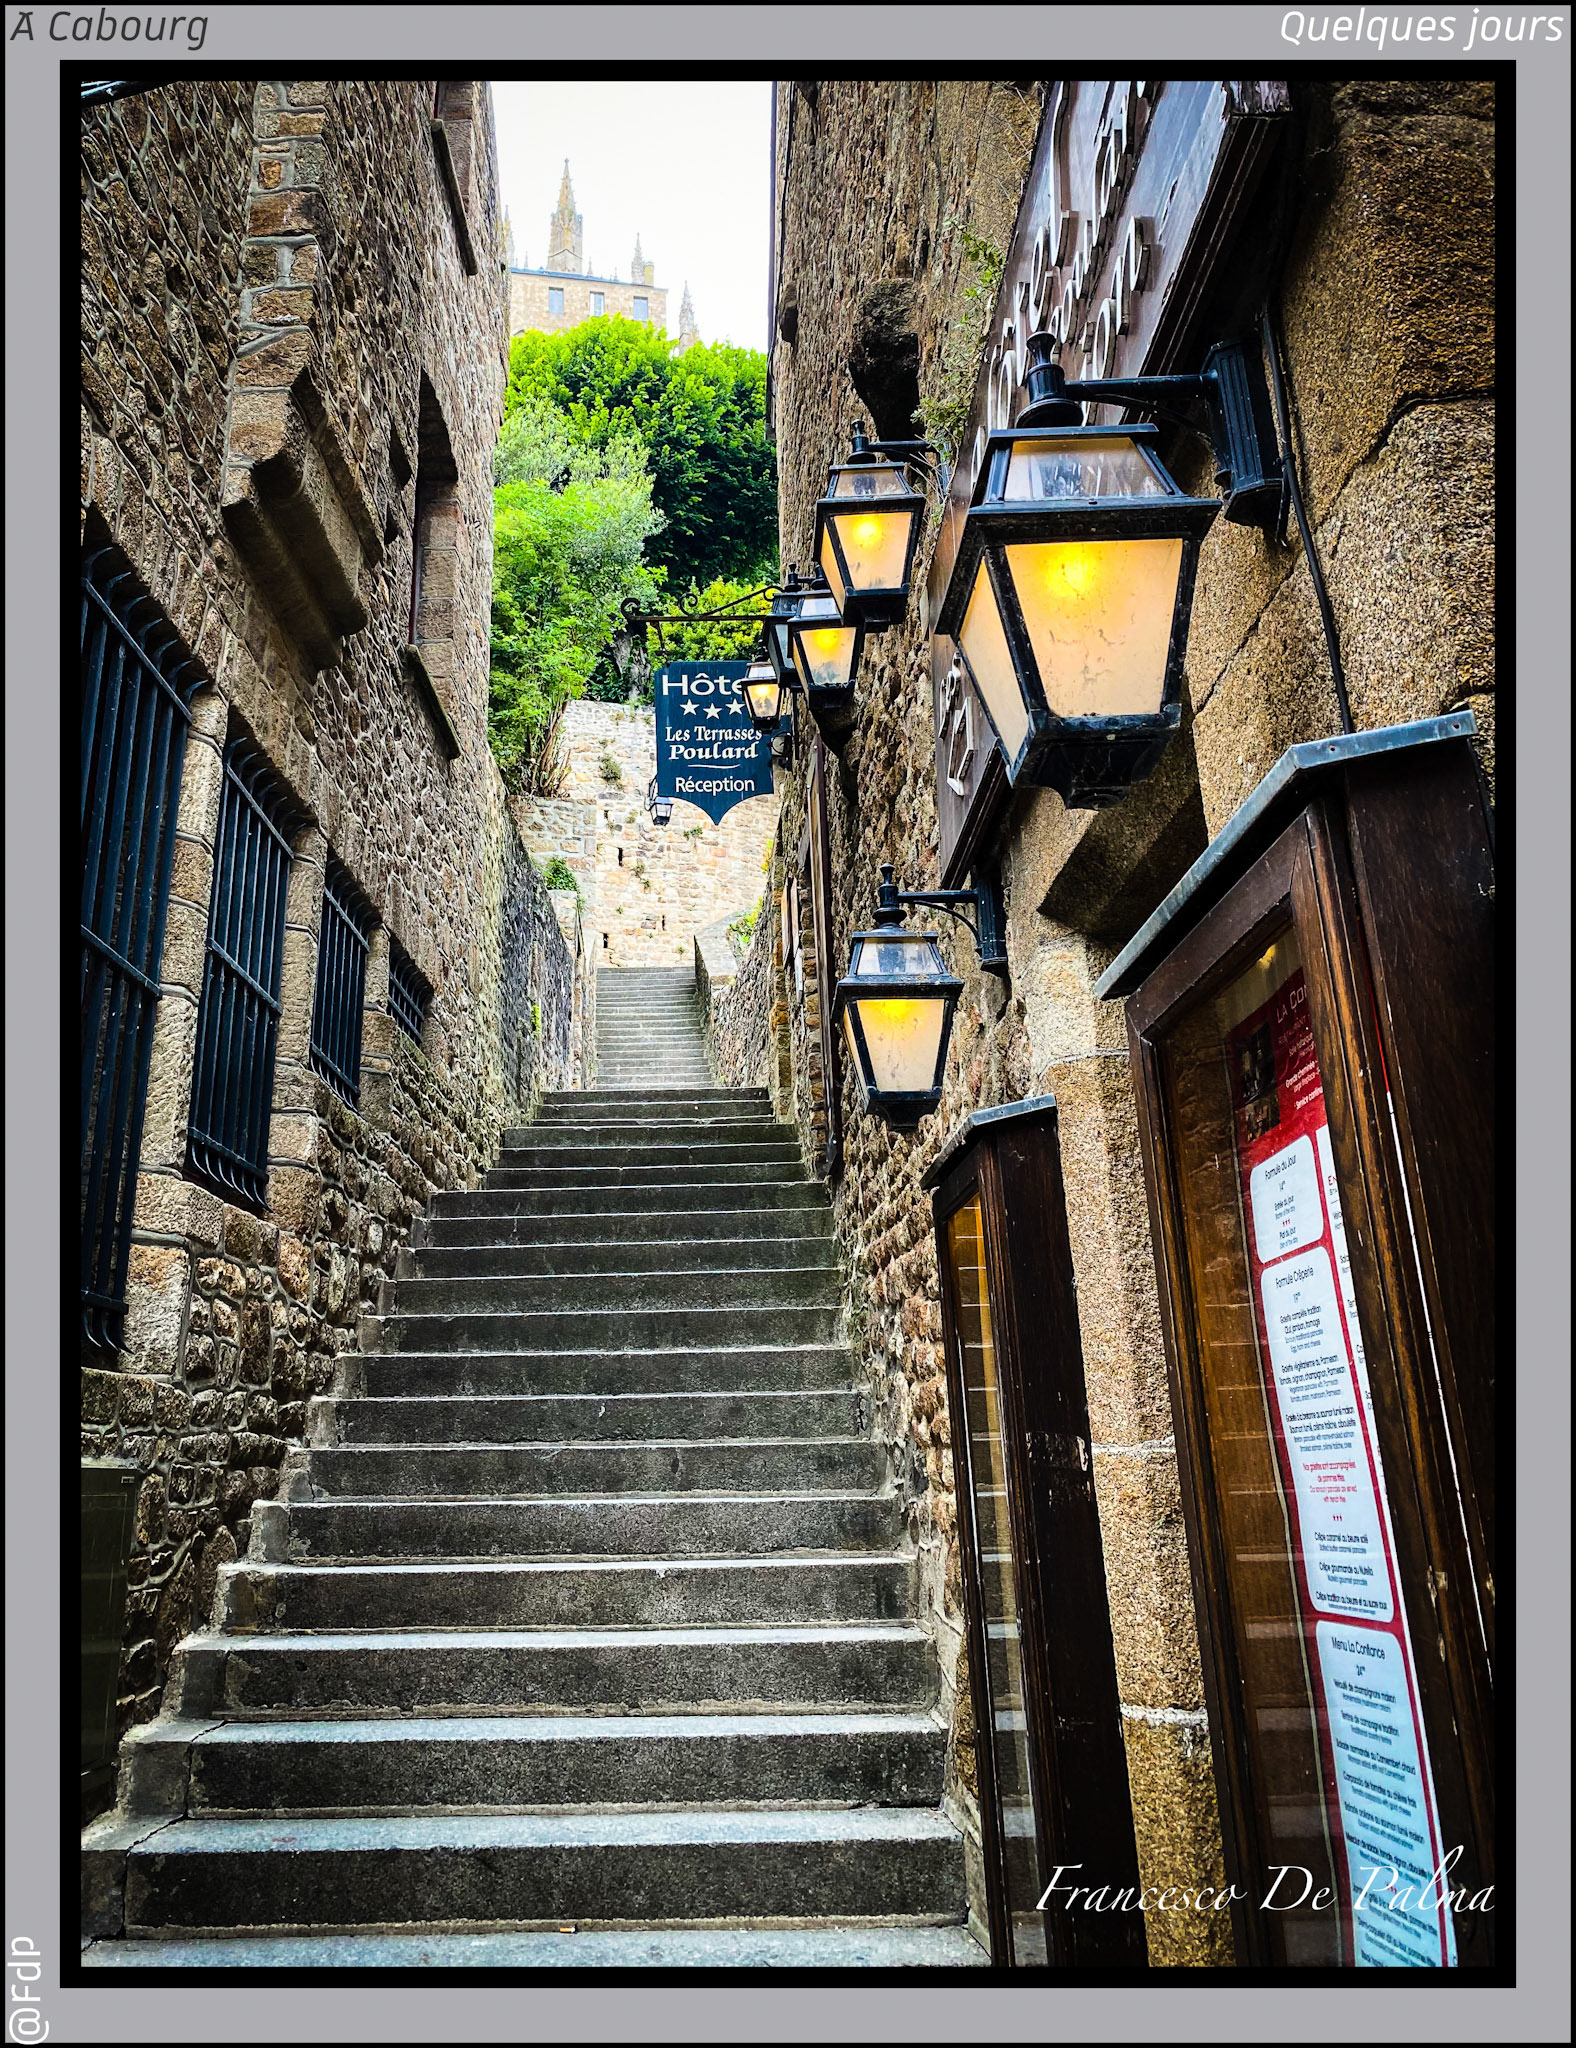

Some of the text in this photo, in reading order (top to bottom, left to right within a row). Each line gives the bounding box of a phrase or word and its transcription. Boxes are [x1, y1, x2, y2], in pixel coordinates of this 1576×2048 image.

[662, 673, 743, 696] Hôte
[665, 726, 762, 741] Les Terrasses
[668, 742, 759, 761] Poulard
[675, 776, 755, 796] Réception
[1265, 1164, 1281, 1181] Formule
[1287, 1155, 1297, 1168] Jour
[1276, 1265, 1314, 1288] Formule Crêperie
[1331, 1636, 1385, 1660] Menu La Confiance
